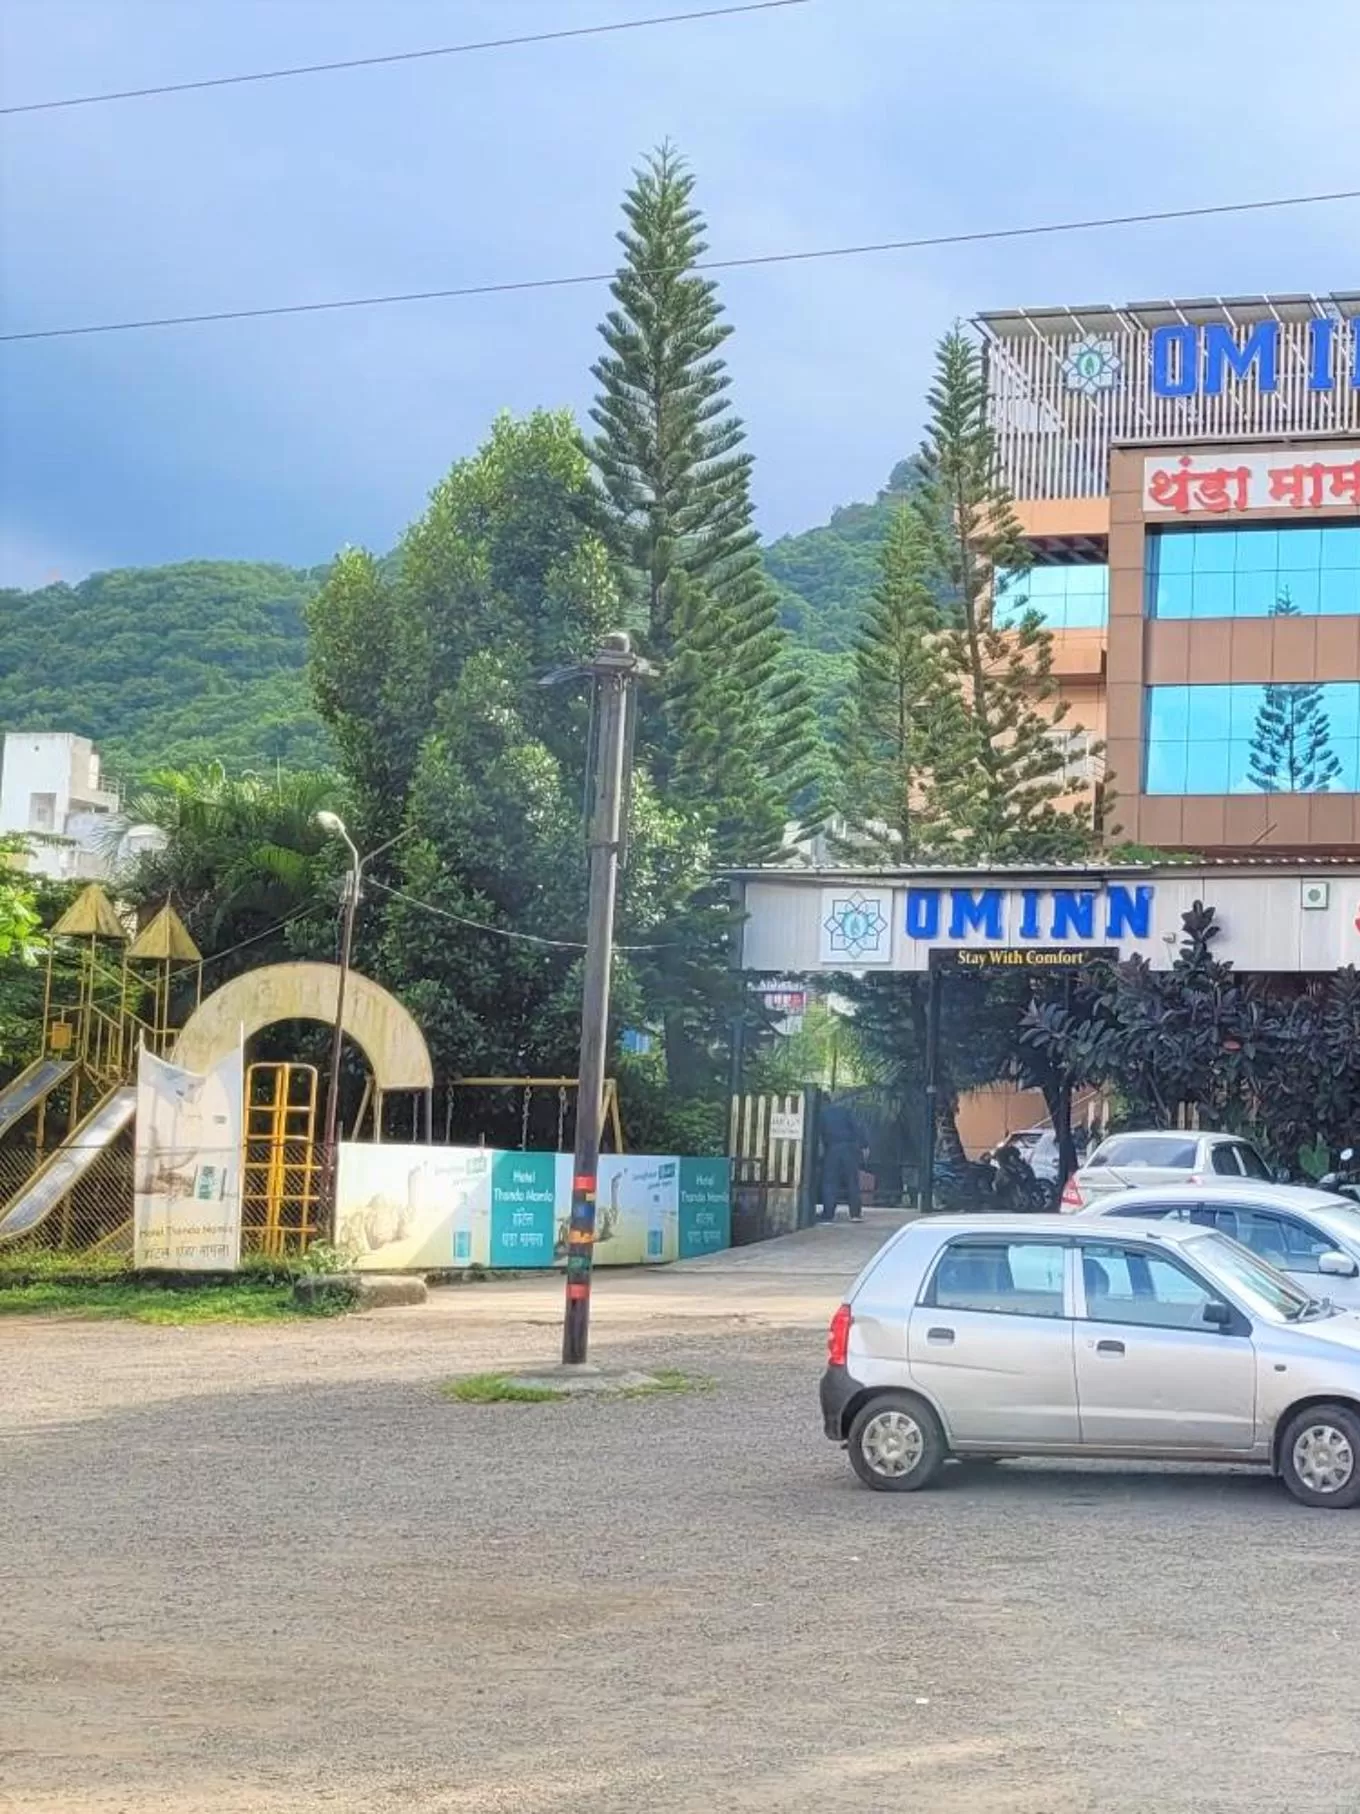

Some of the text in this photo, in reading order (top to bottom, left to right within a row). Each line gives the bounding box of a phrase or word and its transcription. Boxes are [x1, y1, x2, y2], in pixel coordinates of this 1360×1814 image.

[1151, 318, 1281, 398] OM
[1149, 456, 1252, 514] थंडा
[905, 885, 1155, 940] OM INN
[958, 949, 1083, 969] Stay With Comfort
